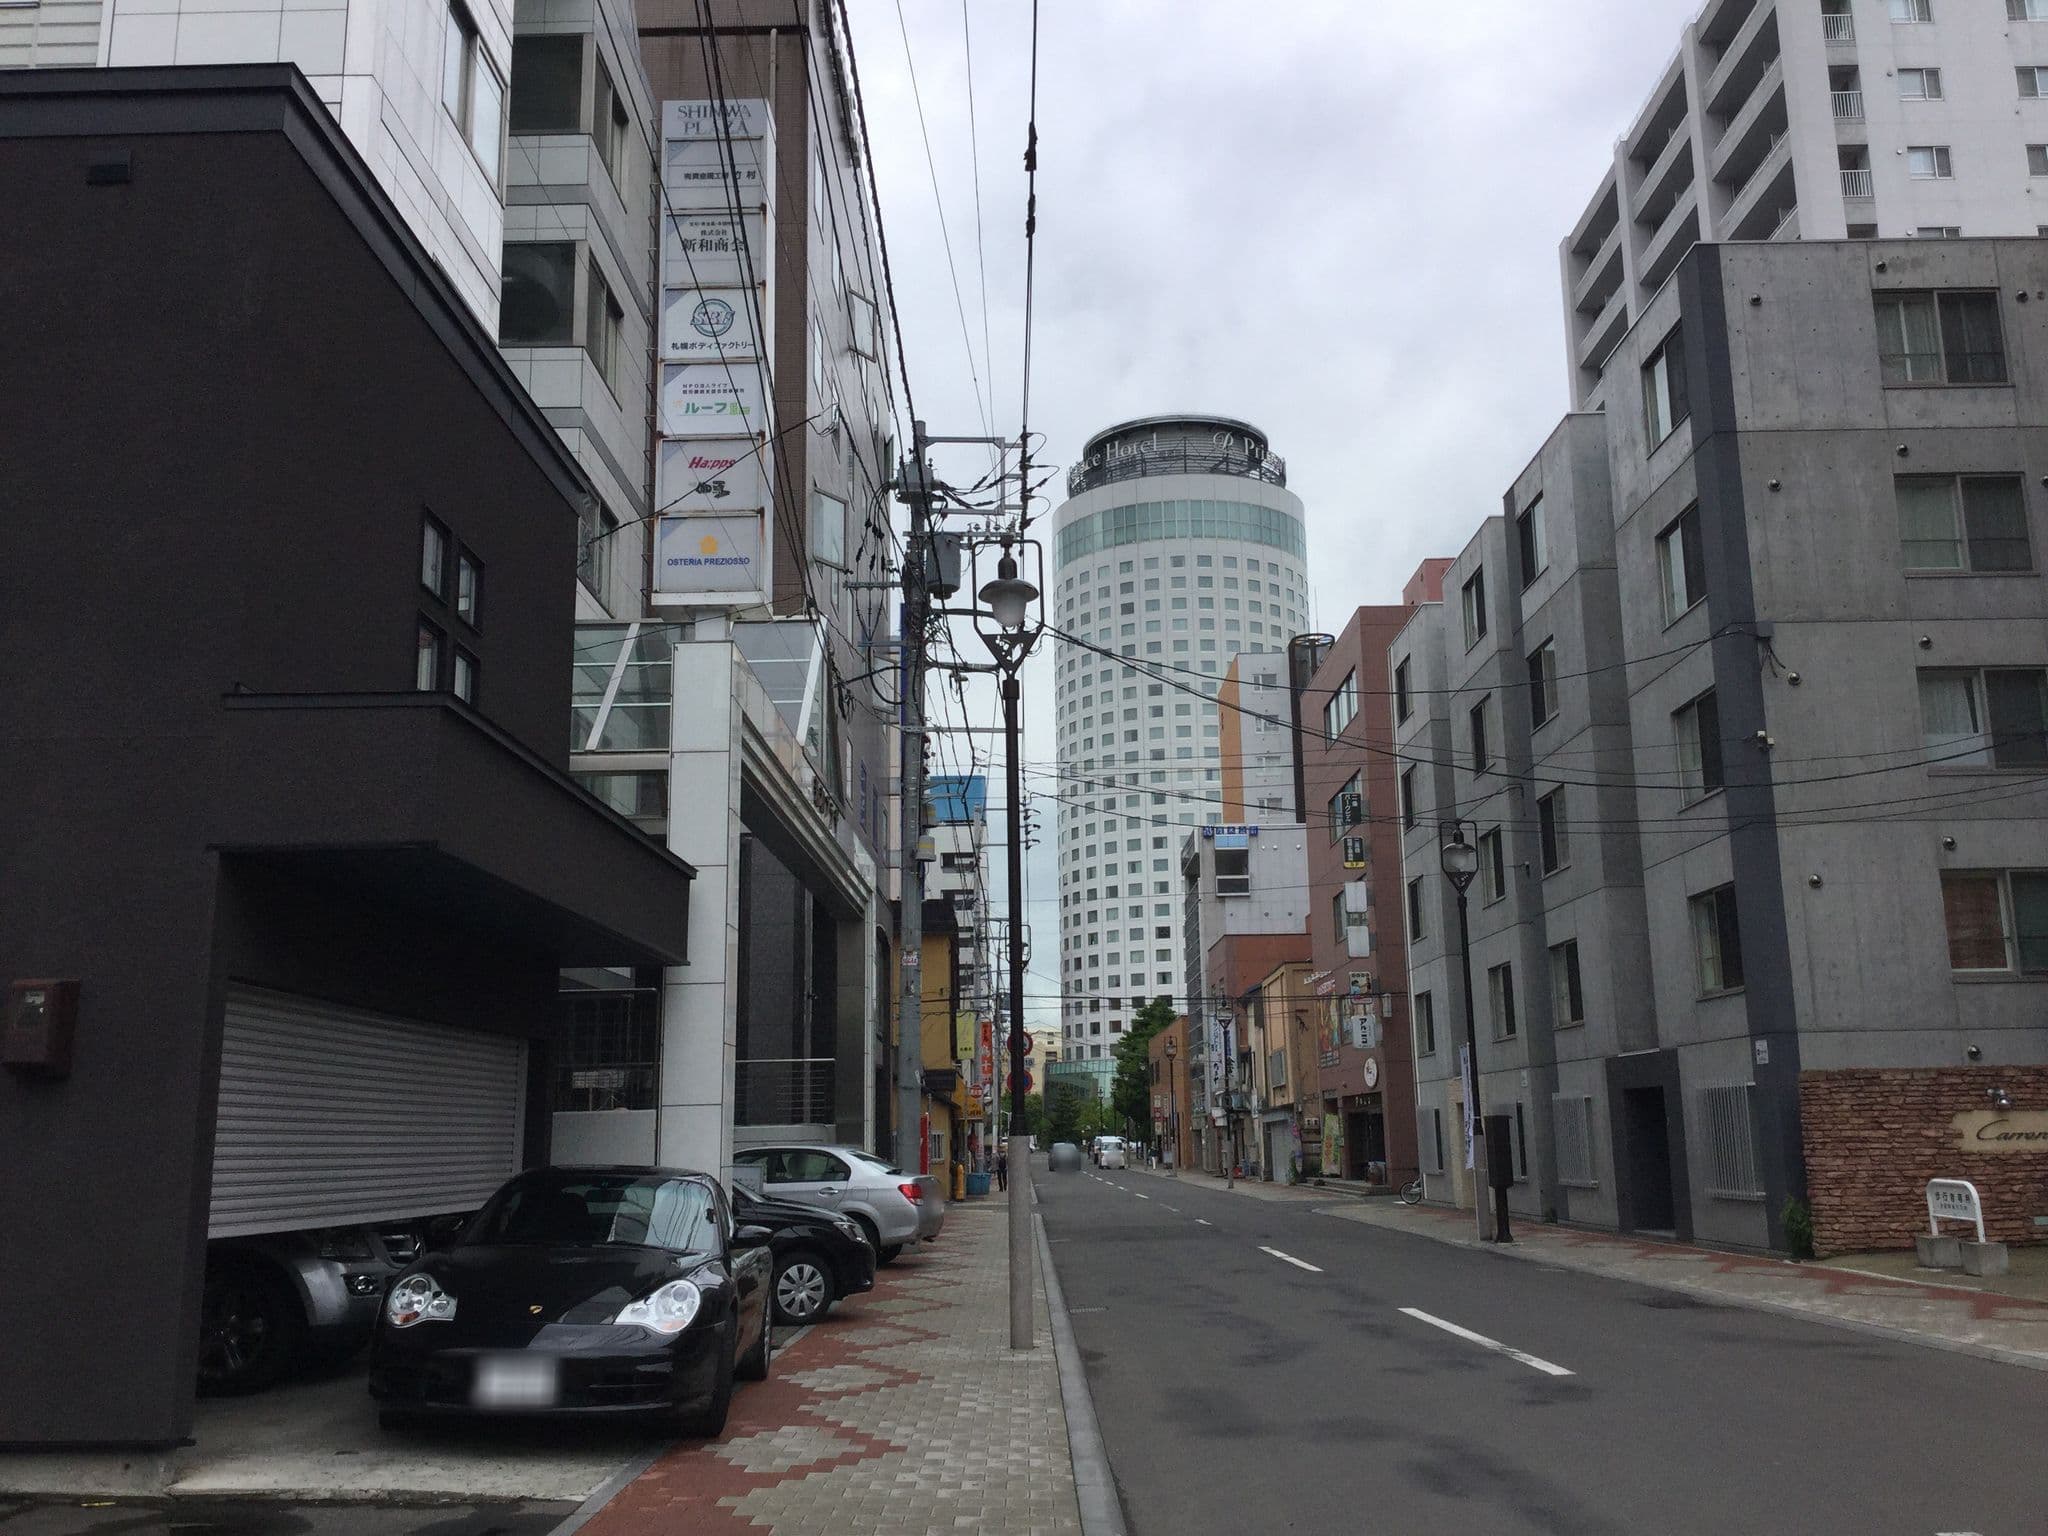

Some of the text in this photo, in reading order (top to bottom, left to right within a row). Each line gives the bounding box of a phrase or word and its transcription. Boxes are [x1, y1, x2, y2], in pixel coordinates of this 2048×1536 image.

[678, 105, 752, 119] SHINWA
[684, 122, 749, 135] PLAZA
[671, 342, 755, 351] 札幌ボディファクトリー
[1106, 432, 1159, 461] Hotel
[667, 558, 702, 566] OSTERIA
